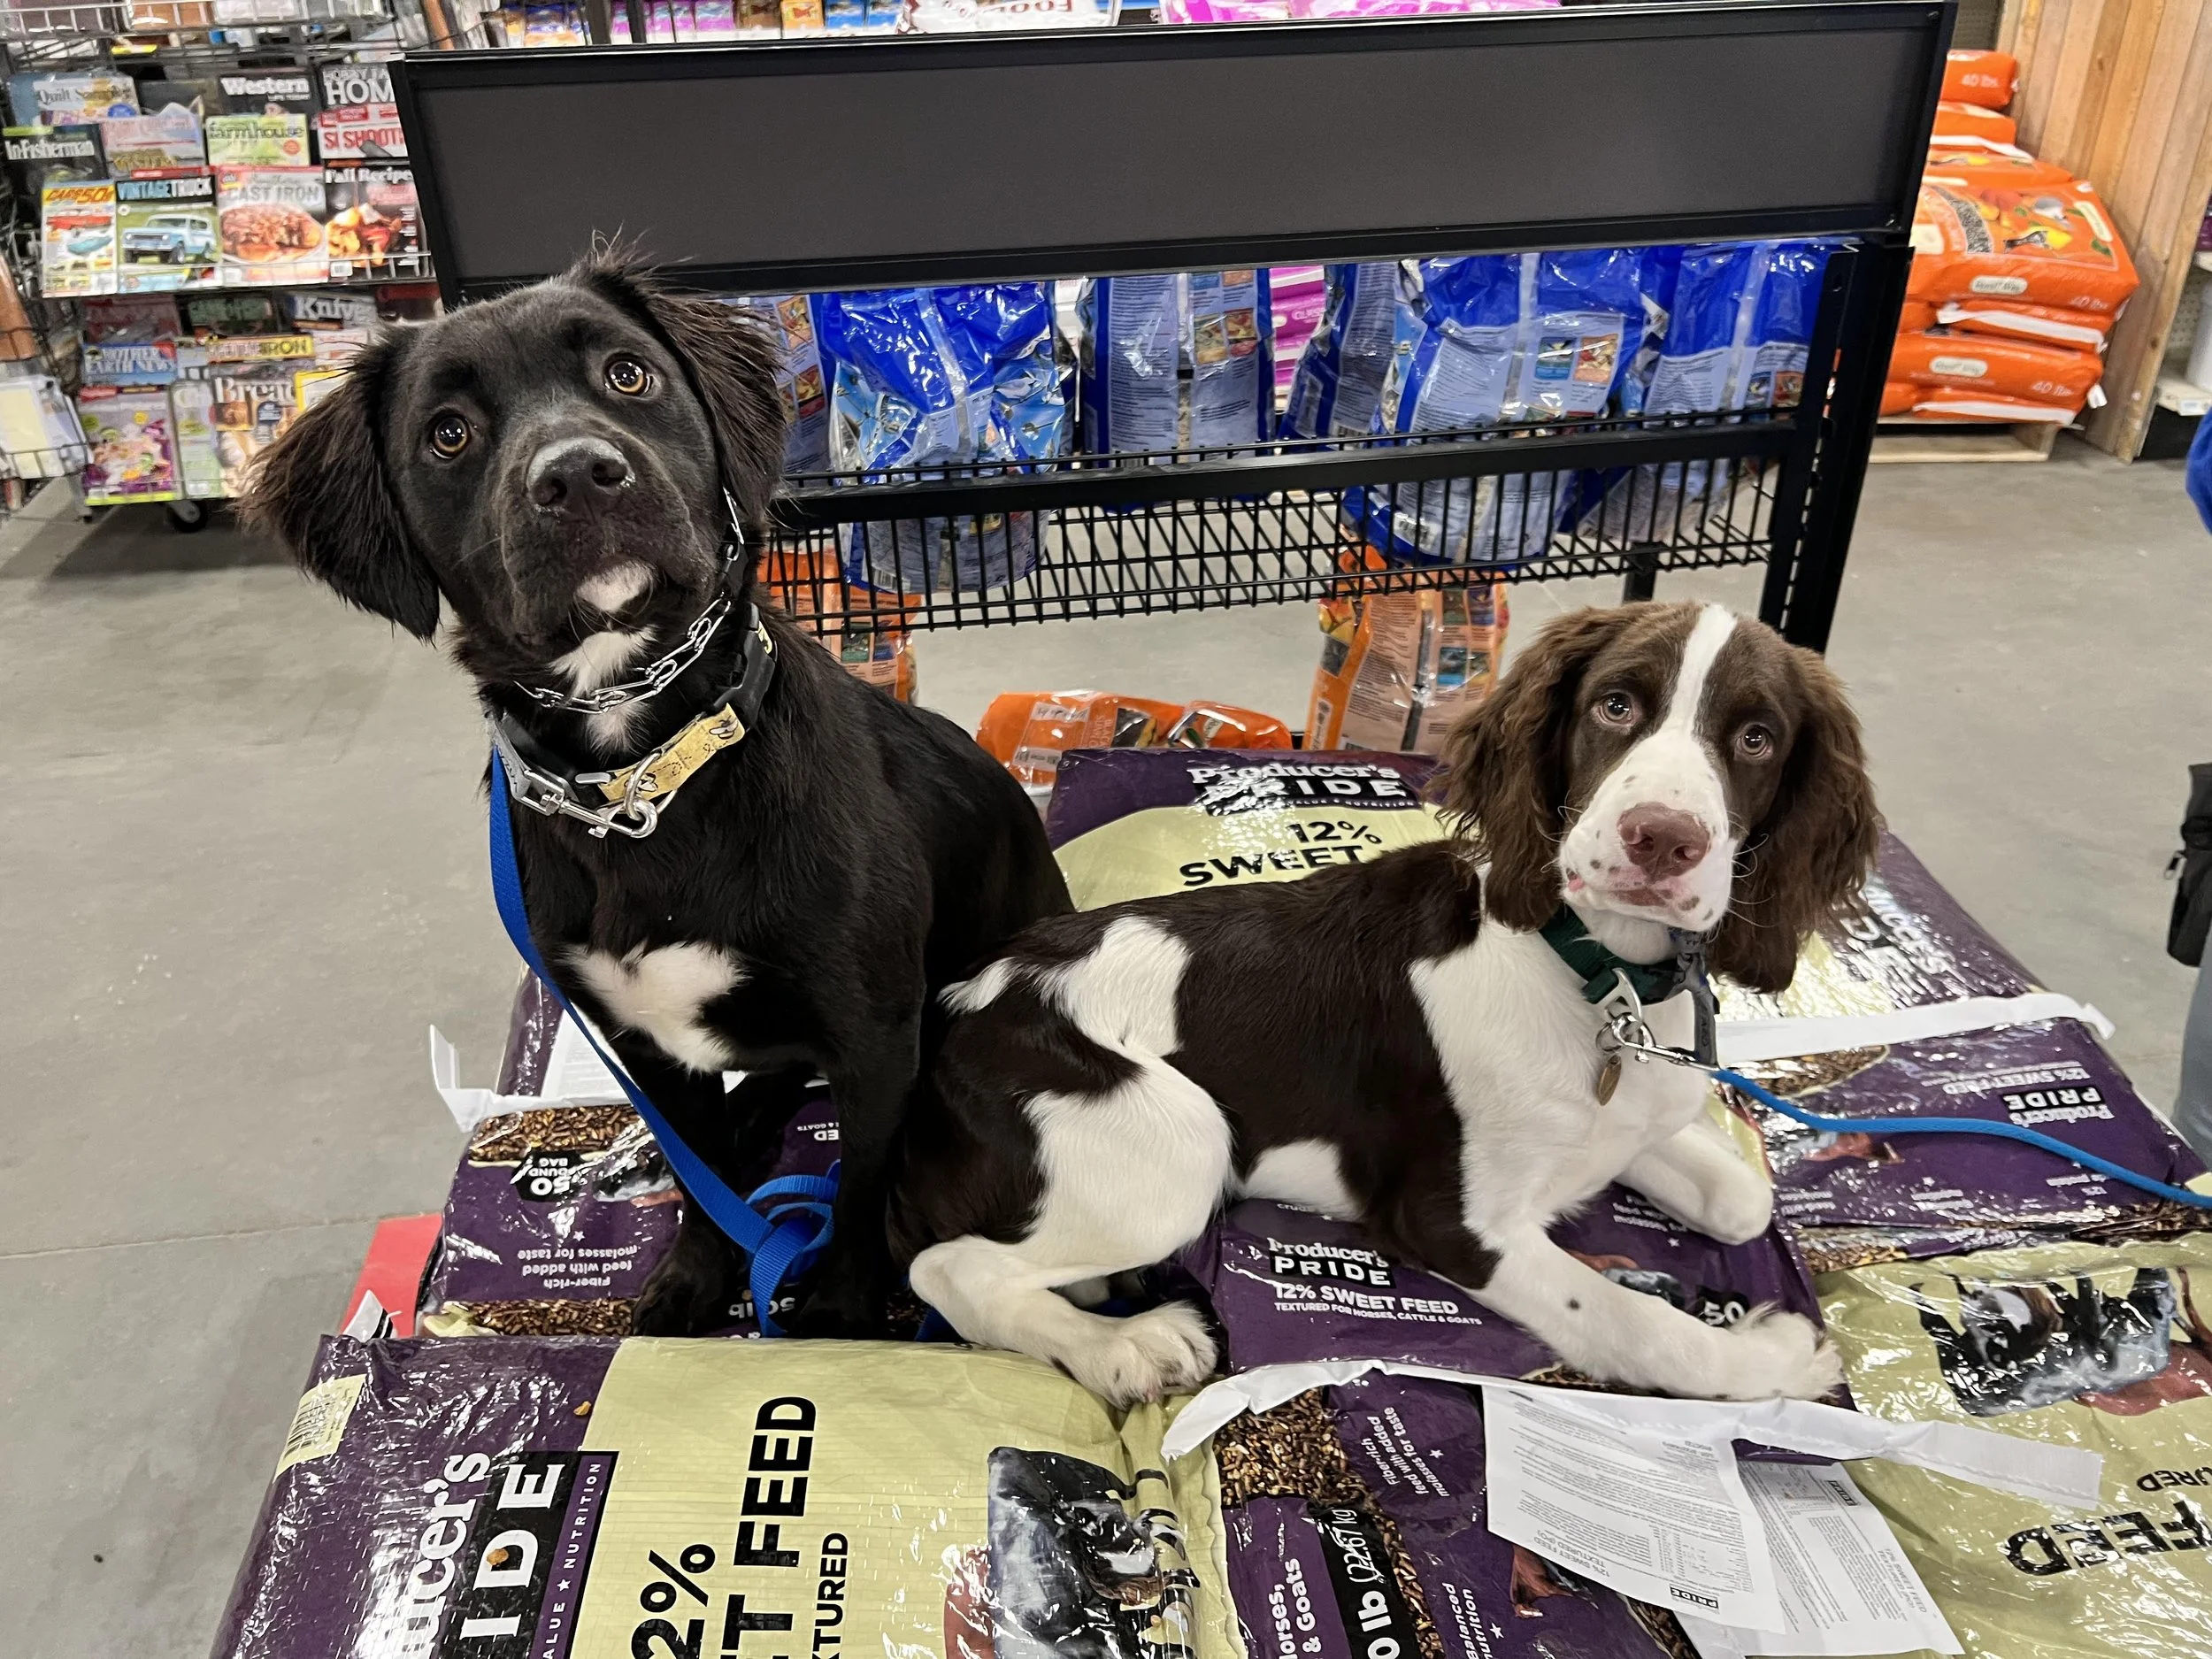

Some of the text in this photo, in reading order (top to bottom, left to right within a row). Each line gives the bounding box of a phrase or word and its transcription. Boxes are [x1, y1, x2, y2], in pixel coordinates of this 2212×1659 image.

[220, 77, 310, 96] Western
[209, 120, 304, 138] farmhouse
[229, 184, 319, 202] CAST IRON
[1187, 763, 1401, 785] Producer's
[1345, 799, 1415, 808] NUTRITION
[1286, 820, 1383, 845] 12%
[1179, 844, 1363, 887] SWEET
[1992, 1070, 2055, 1089] SWEET
[2002, 1087, 2102, 1110] PRIDE
[2008, 1102, 2115, 1128] Producer's
[796, 1123, 826, 1132] GOATS
[538, 1157, 569, 1167] BAG
[530, 1176, 572, 1195] 50
[517, 1245, 638, 1261] molasses for taste
[1267, 1237, 1389, 1269] Producer's
[522, 1260, 633, 1277] feed with added
[1274, 1256, 1391, 1286] PRIDE
[543, 1276, 611, 1289] Fiber-rich
[728, 1302, 754, 1318] lb
[1274, 1283, 1459, 1315] 12% SWEET FEED
[1273, 1302, 1331, 1313] TEXTURED
[1330, 1303, 1353, 1316] FOR
[1353, 1307, 1397, 1321] HORSES,
[1397, 1312, 1438, 1324] CATTLE
[1446, 1315, 1483, 1325] GOATS
[1703, 1299, 1747, 1327] 50
[1367, 1417, 1395, 1453] added
[1361, 1439, 1401, 1485] Fiber-rich
[1384, 1407, 1450, 1496] molasses for taste
[1390, 1455, 1411, 1473] with
[733, 1396, 817, 1567] FEED
[564, 1462, 601, 1570] NUTRITION
[1532, 1536, 1558, 1553] FEED
[2004, 1500, 2212, 1577] FEED
[460, 1463, 566, 1644] IDE
[1555, 1540, 1604, 1568] TEXTURED
[1559, 1549, 1591, 1570] SWEET
[1285, 1557, 1322, 1655] Goats &
[1670, 1587, 1717, 1609] PRIDE
[1268, 1583, 1299, 1659] orses,
